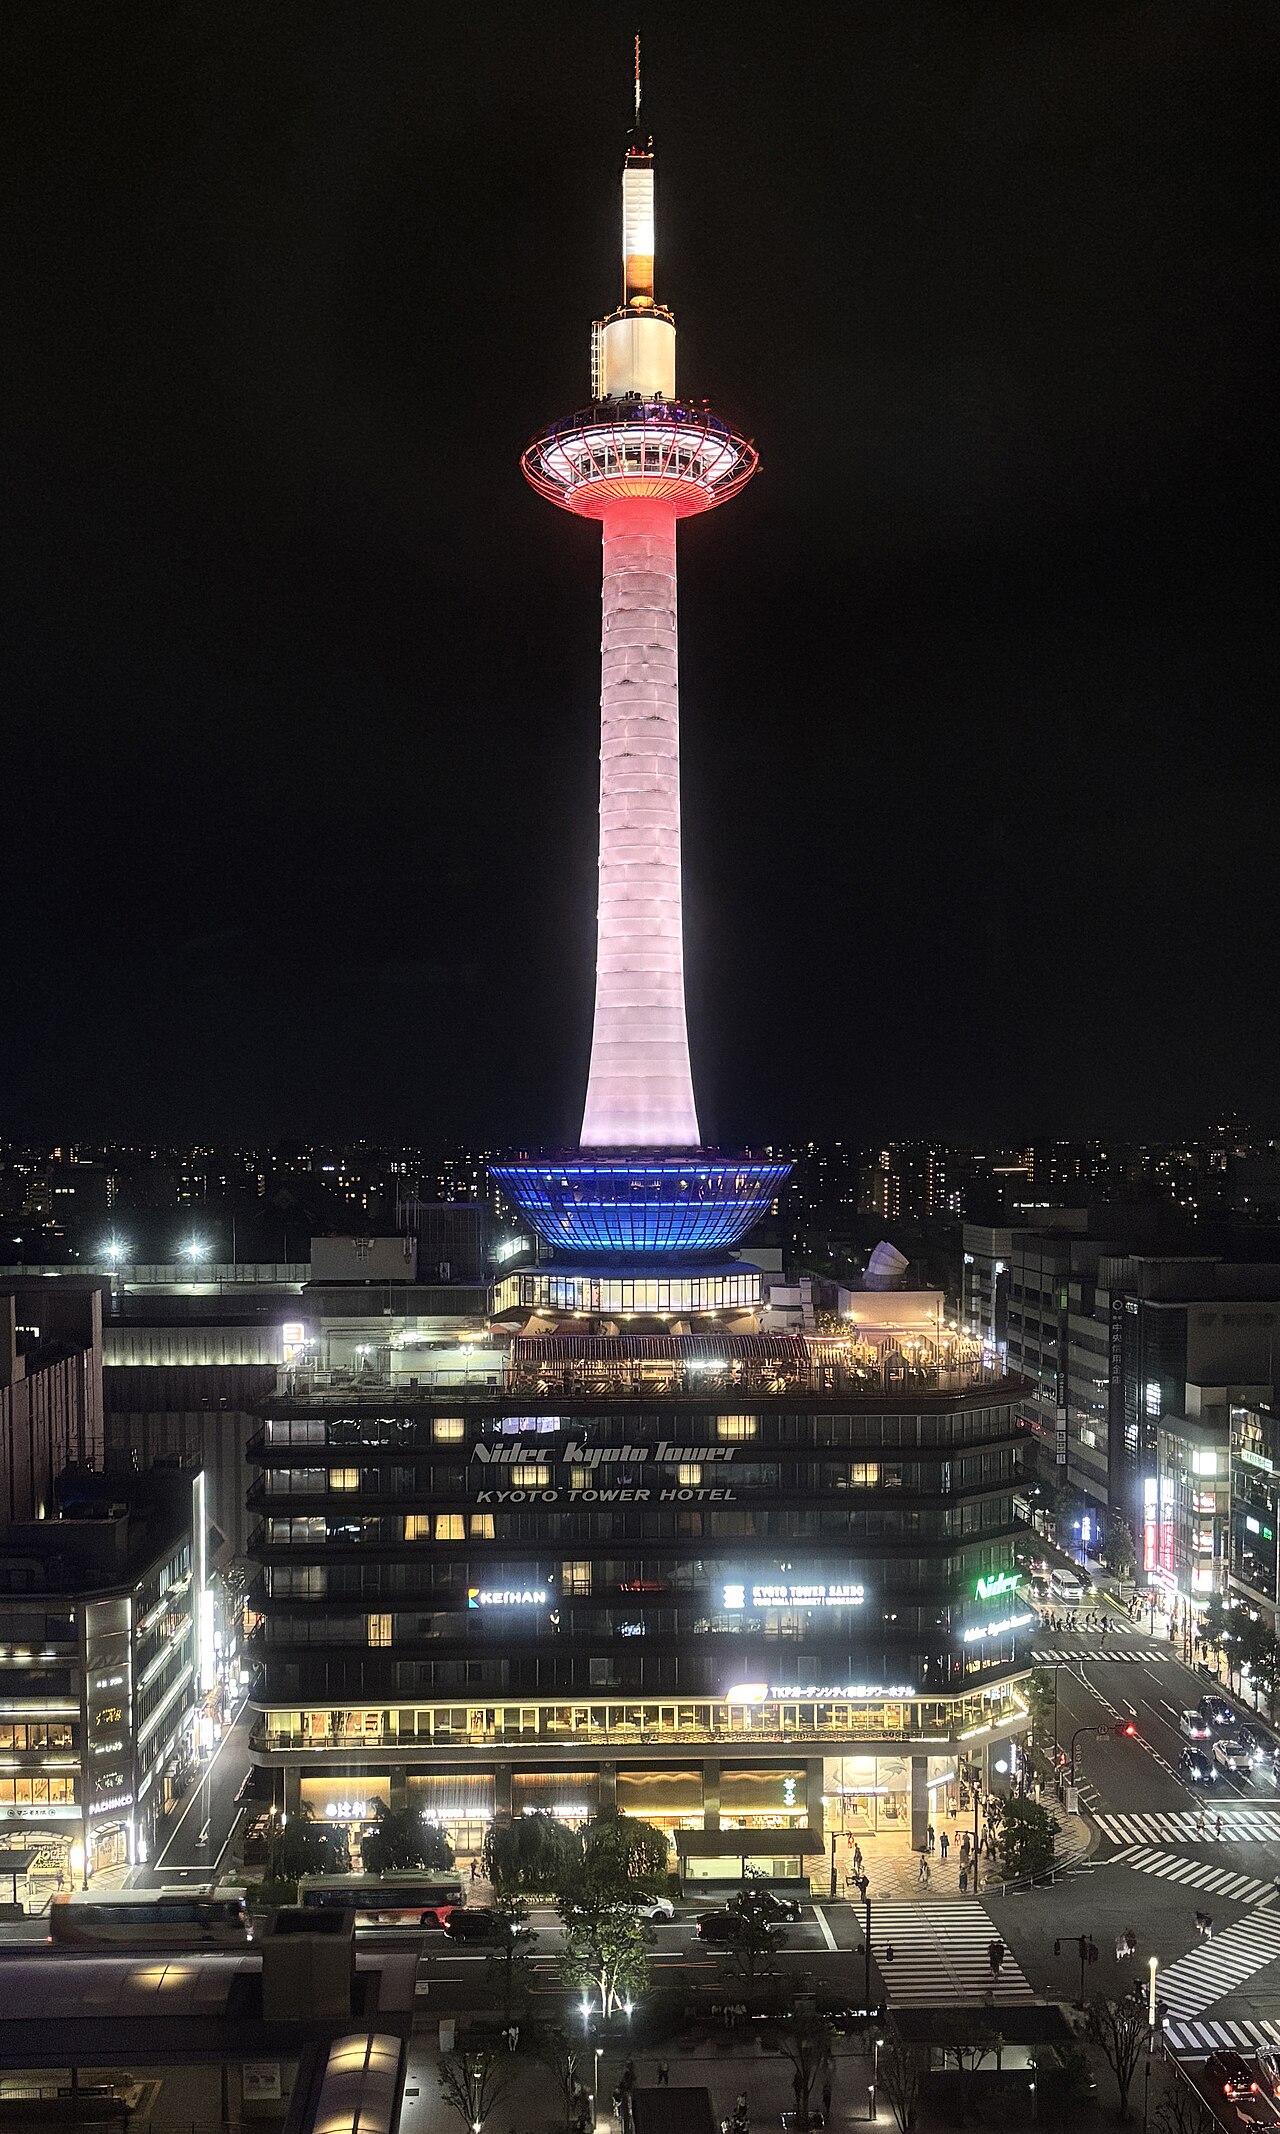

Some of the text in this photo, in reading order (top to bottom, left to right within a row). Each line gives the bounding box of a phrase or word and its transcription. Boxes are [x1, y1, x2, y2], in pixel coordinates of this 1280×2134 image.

[471, 1440, 741, 1469] Nidec Kyoto Tower
[476, 1488, 737, 1503] KYOTO TOWER HOTEL
[753, 1585, 864, 1597] KYOTO TOWER SANDO
[974, 1572, 1022, 1601] Nidec
[480, 1591, 546, 1604] KEIHAN
